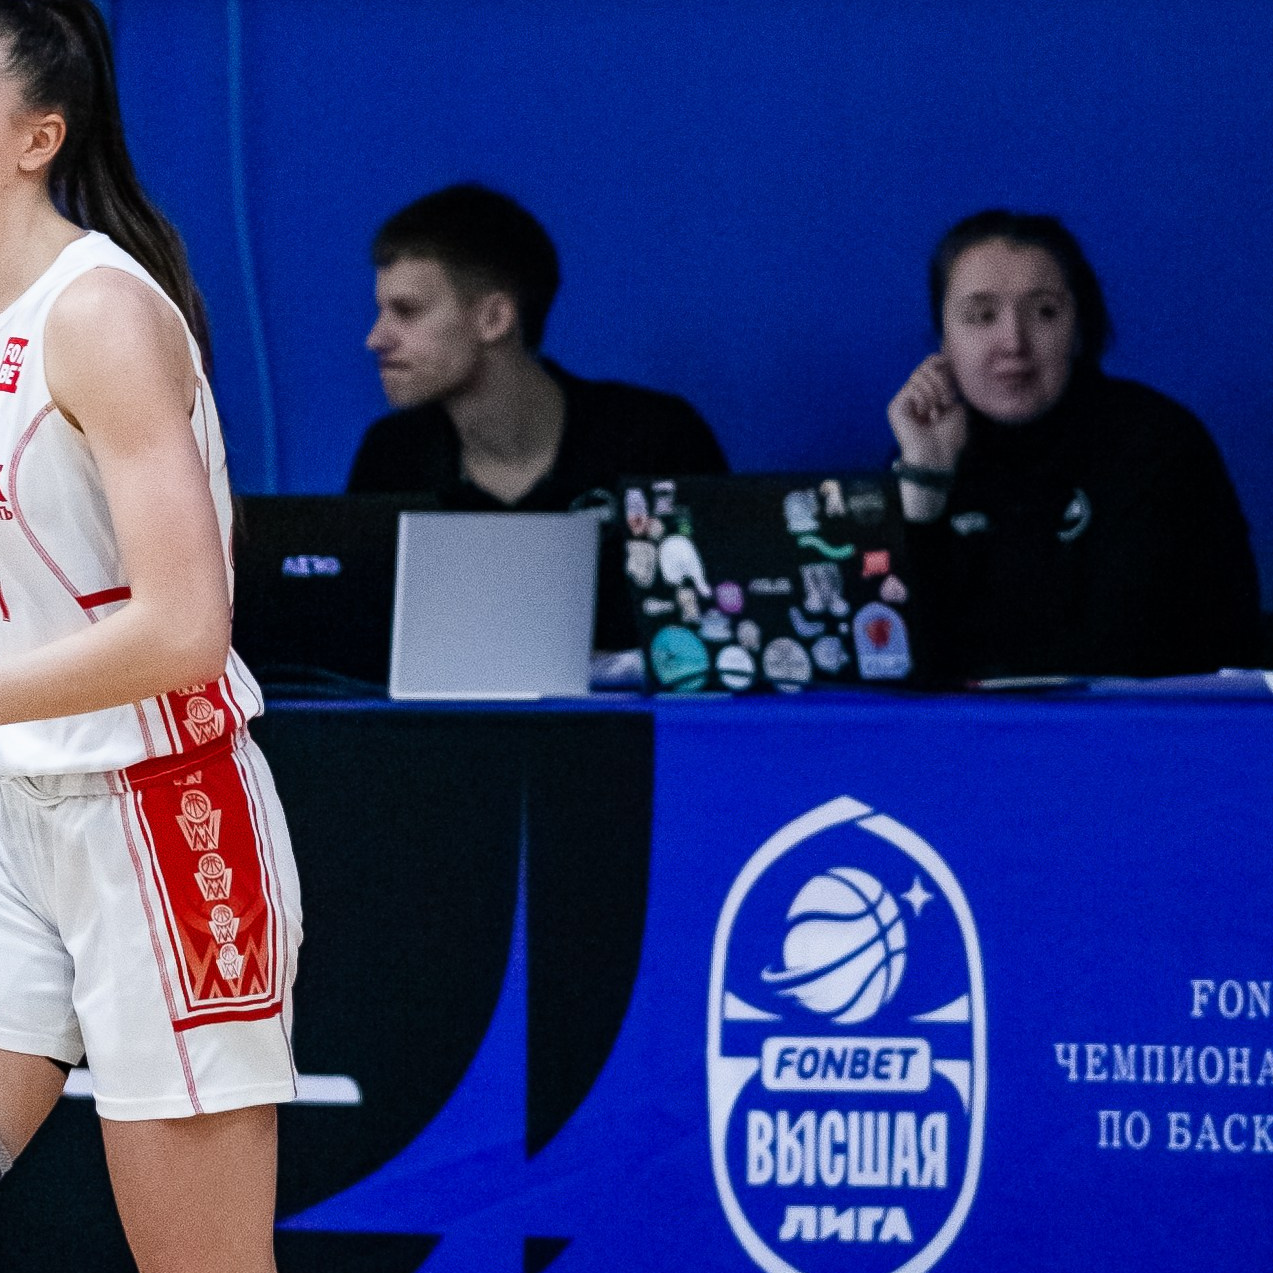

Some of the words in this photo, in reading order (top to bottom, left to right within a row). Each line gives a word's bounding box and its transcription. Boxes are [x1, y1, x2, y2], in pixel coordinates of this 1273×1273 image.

[1190, 979, 1273, 1019] FON
[775, 1047, 919, 1080] FONBET
[1054, 1043, 1273, 1086] ЧЕМПИОНА
[746, 1109, 949, 1188] ВЫСШАЯ
[1097, 1110, 1152, 1151] ПО
[1166, 1111, 1273, 1154] БАСК
[778, 1205, 915, 1243] ЛИГА
